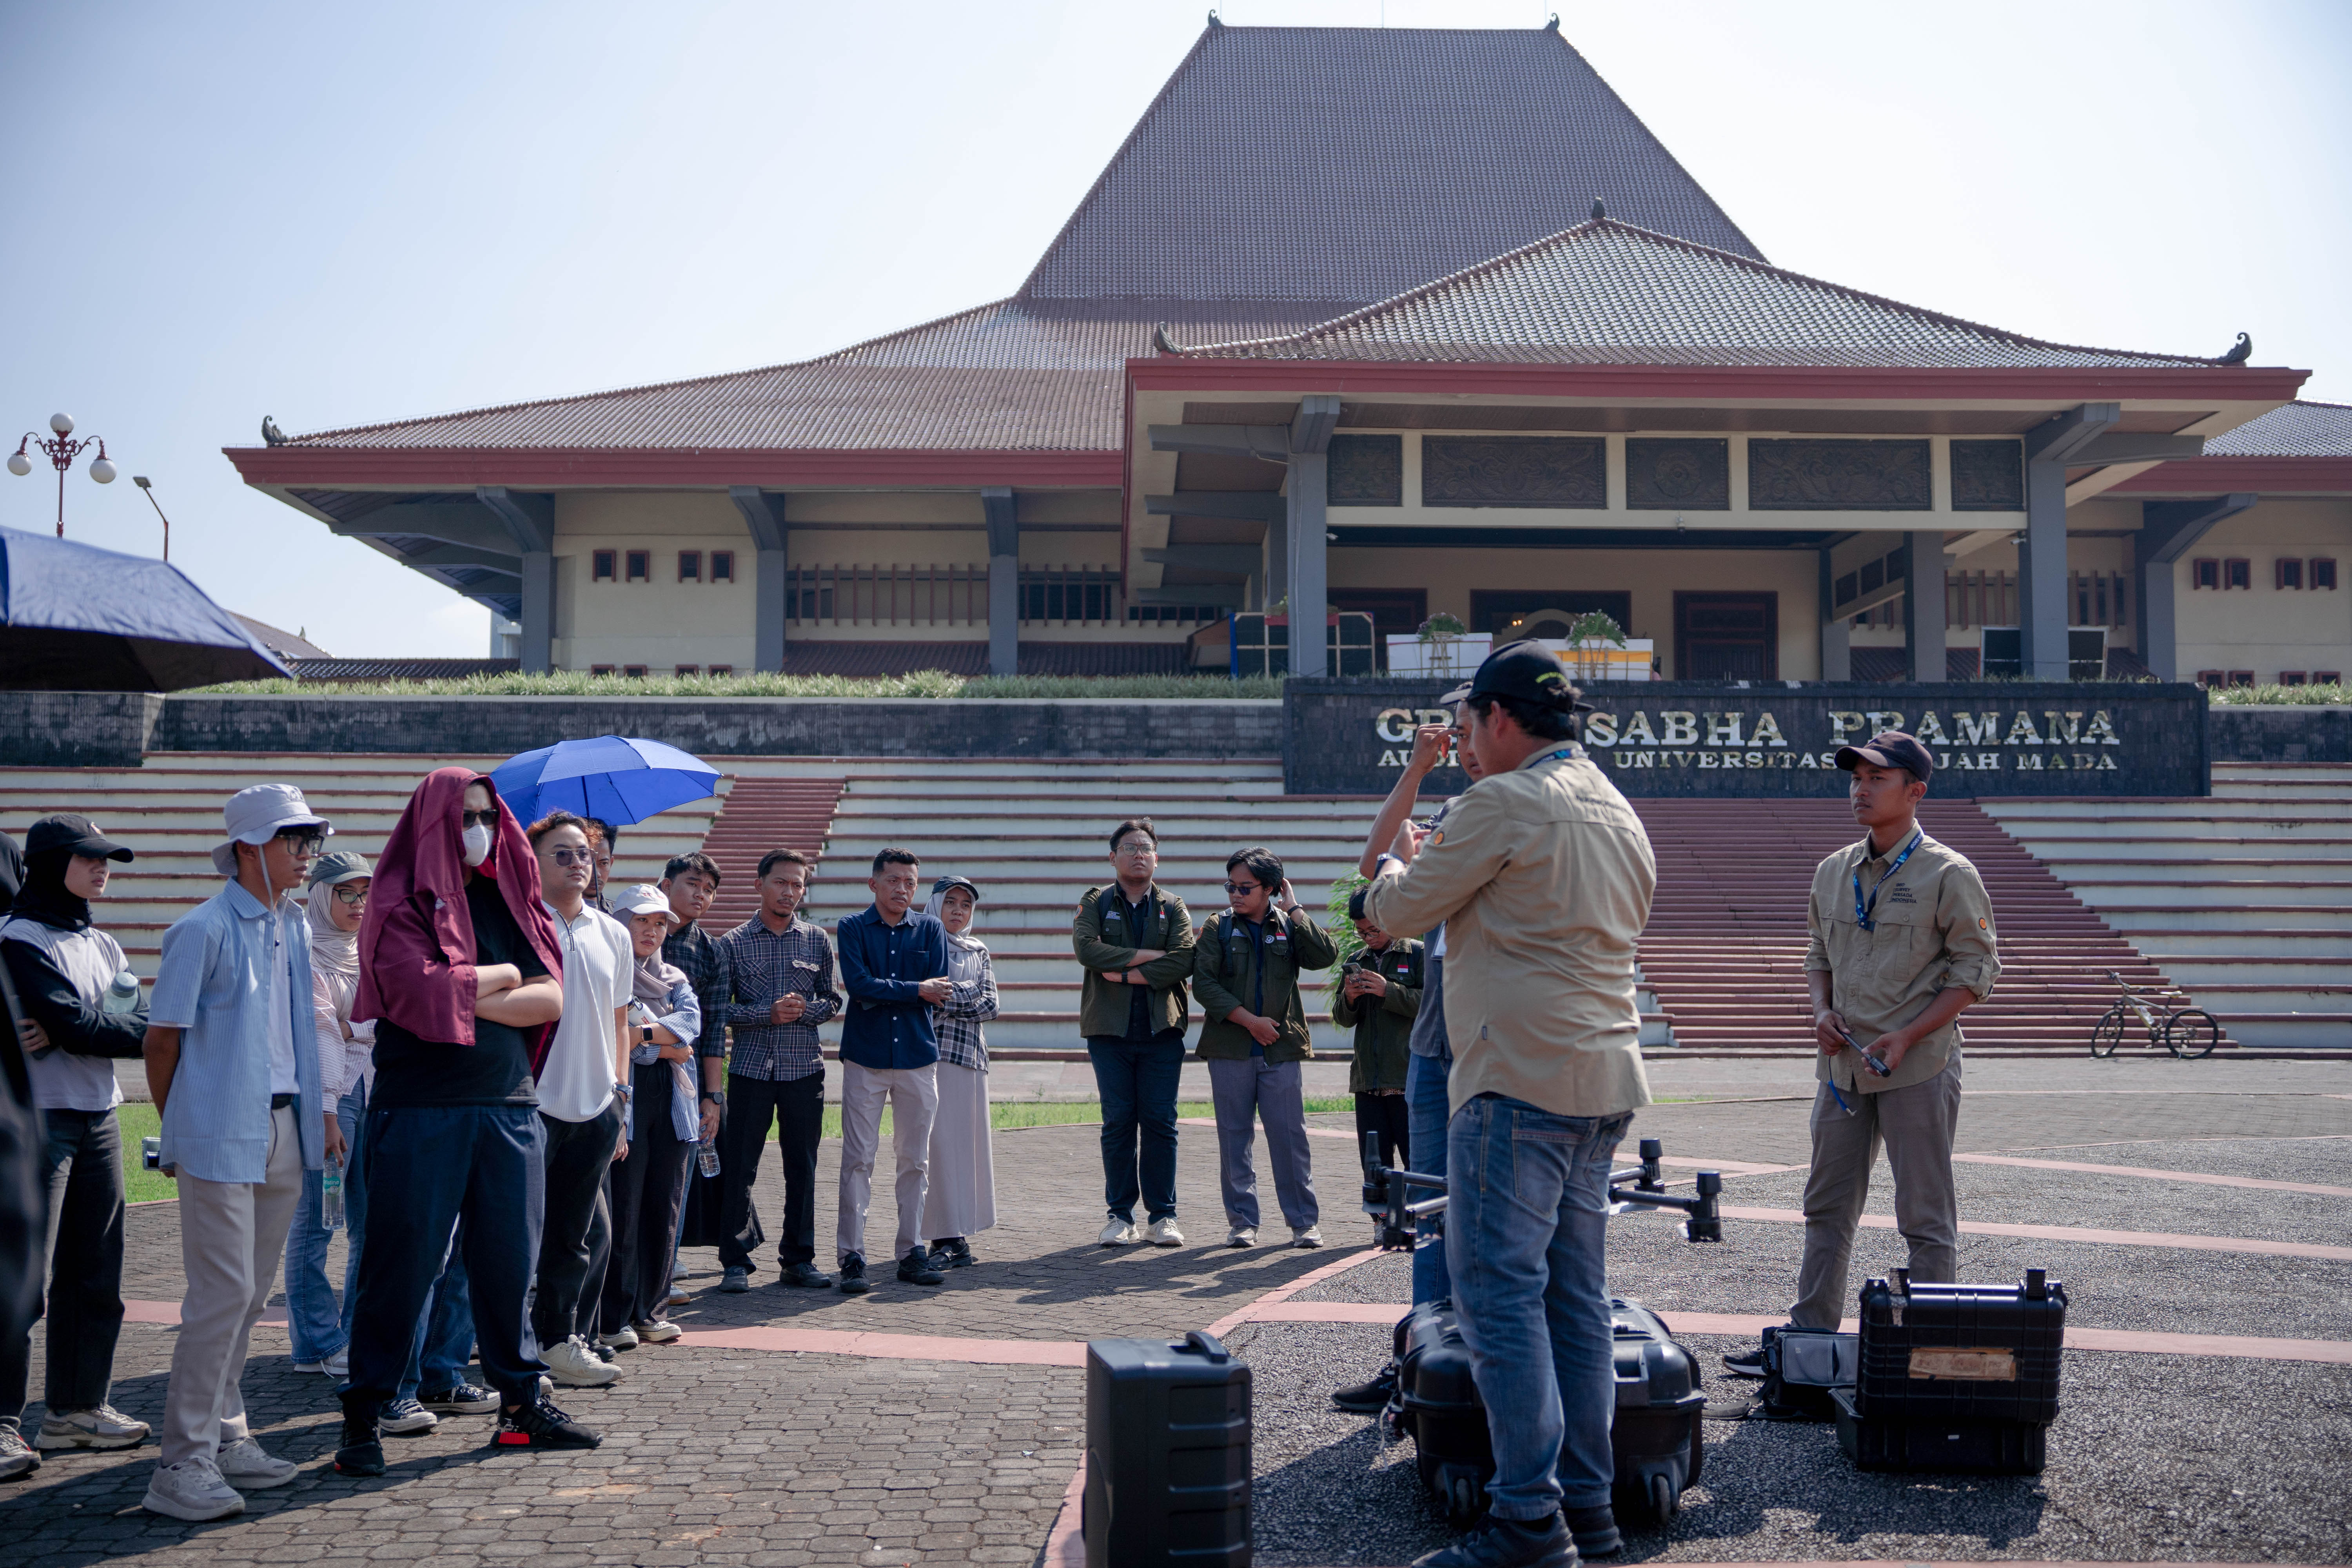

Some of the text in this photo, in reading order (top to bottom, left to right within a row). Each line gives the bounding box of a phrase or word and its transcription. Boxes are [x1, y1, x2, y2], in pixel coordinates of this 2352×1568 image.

[1585, 711, 1788, 747] SABHA
[1829, 710, 2120, 746] PRAMANA
[1613, 751, 1838, 770] UNIVERSITAS
[2016, 753, 2117, 770] MADA
